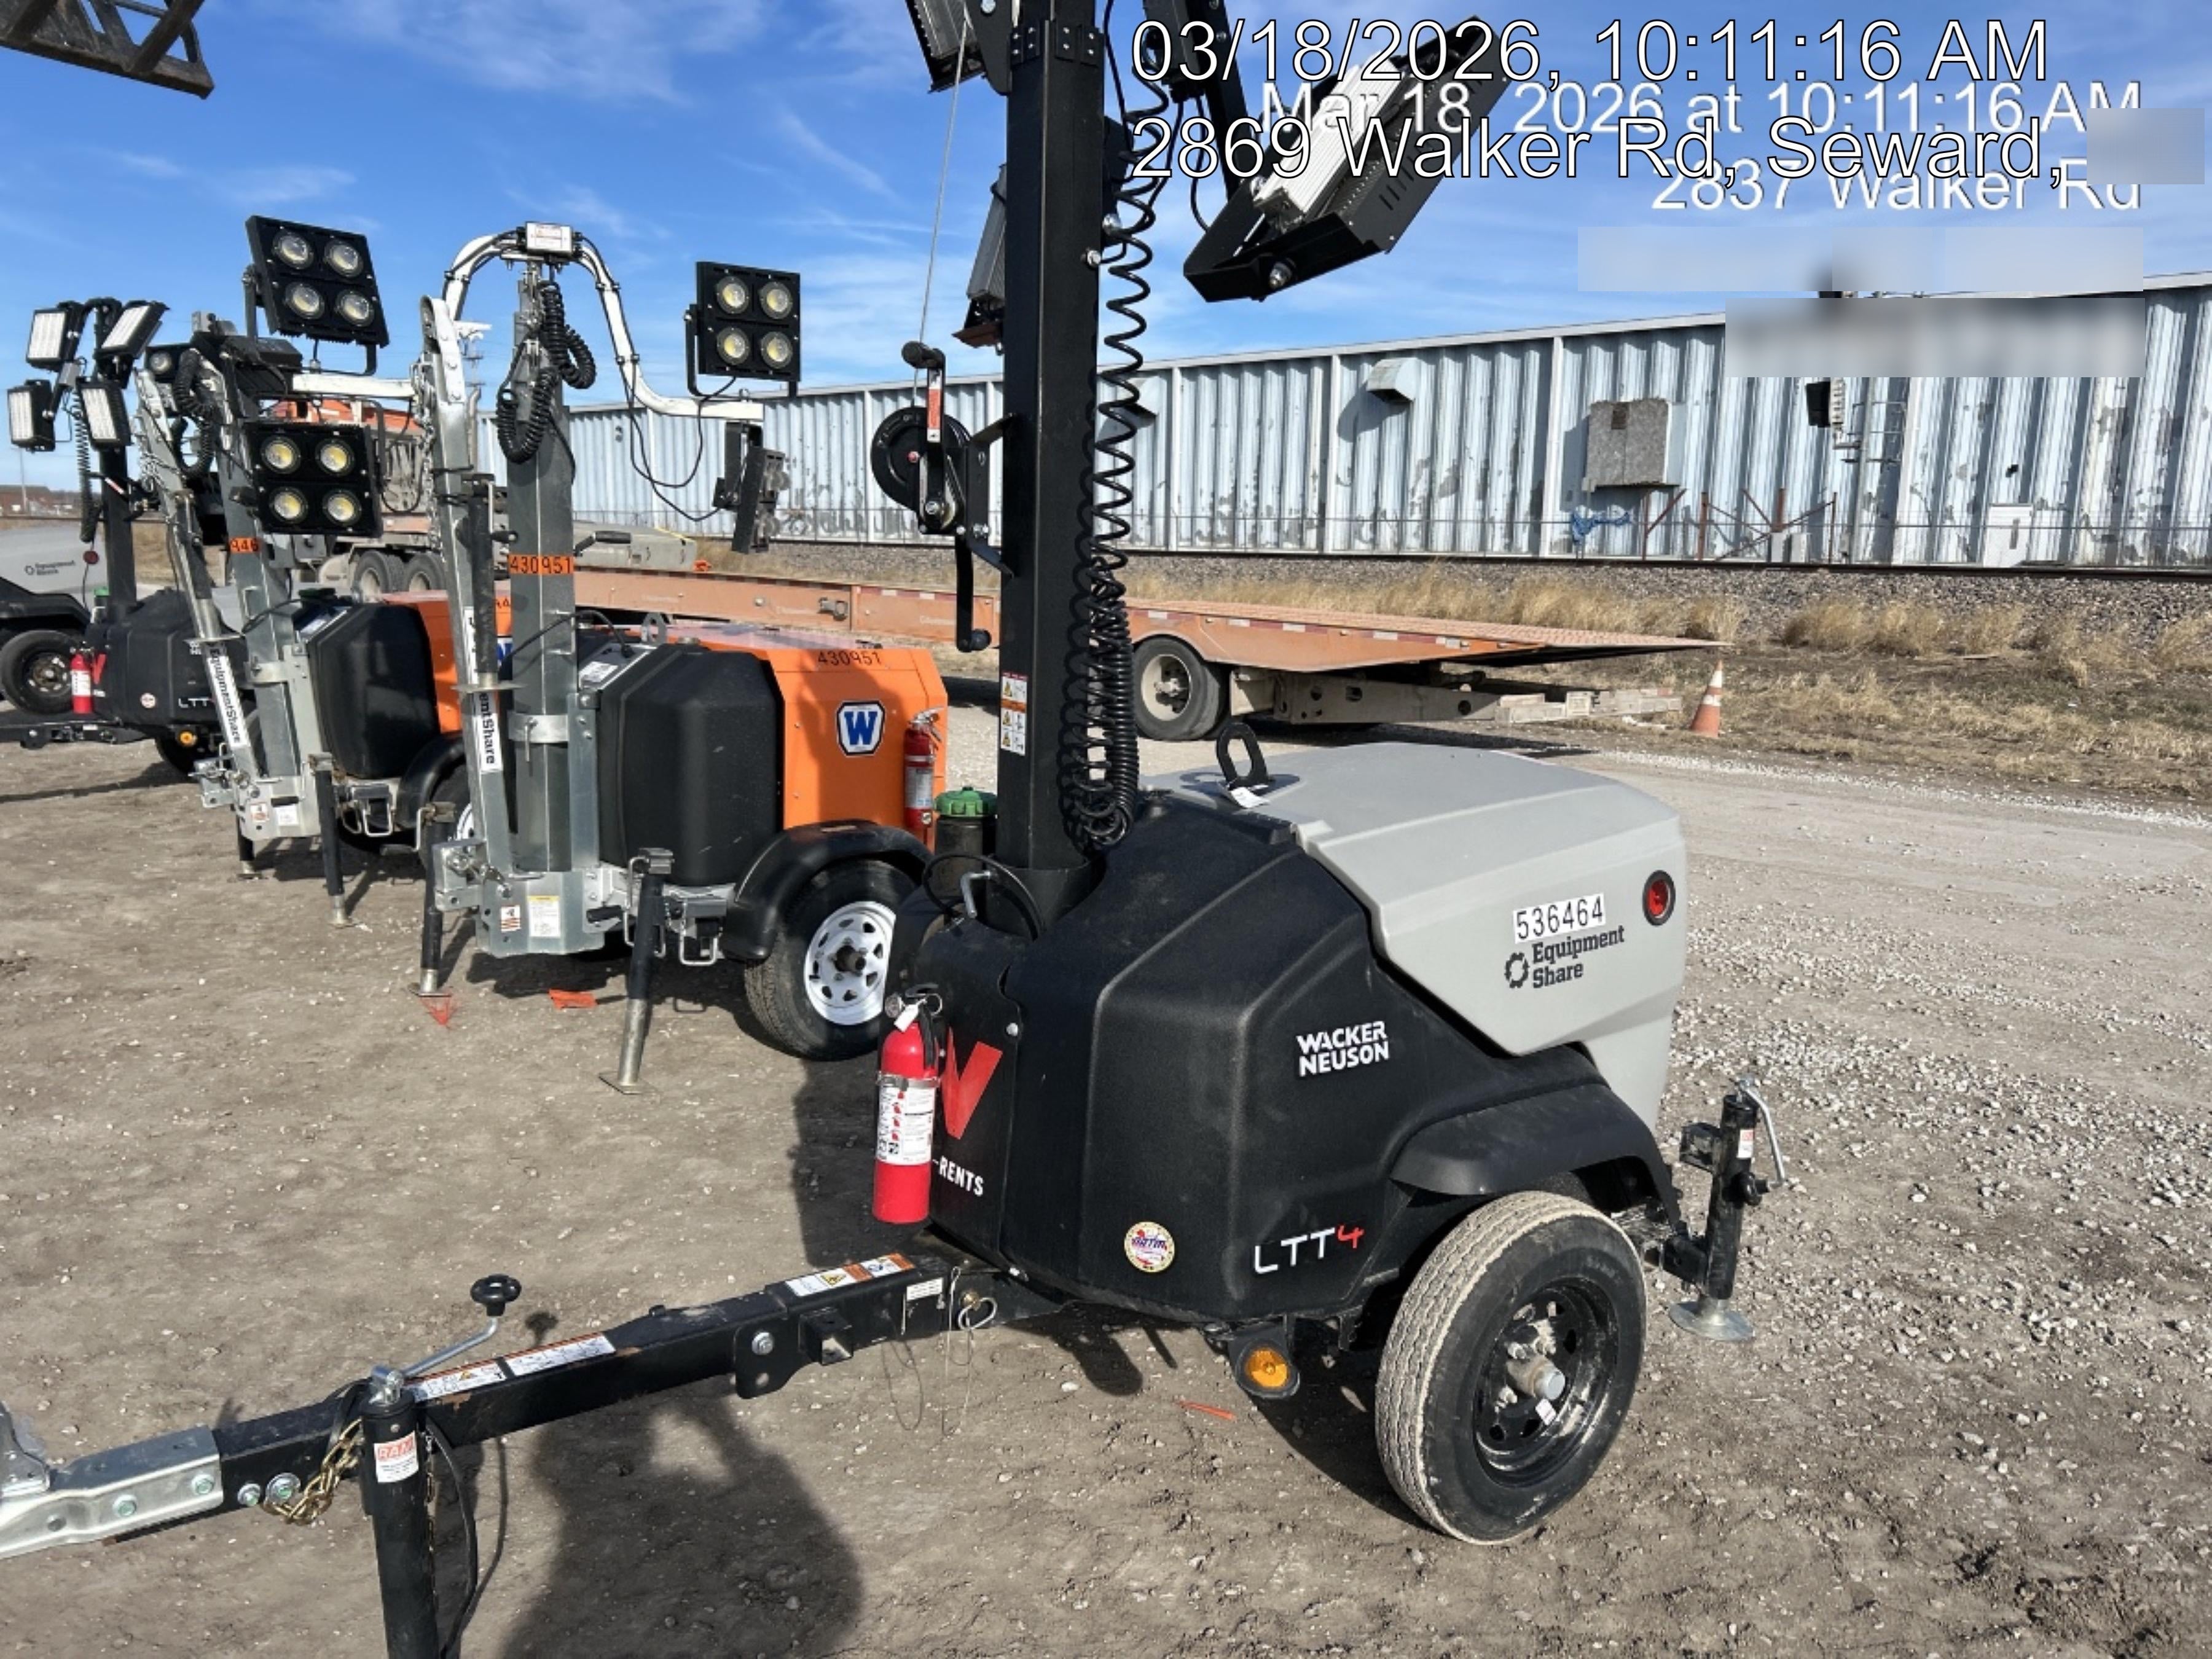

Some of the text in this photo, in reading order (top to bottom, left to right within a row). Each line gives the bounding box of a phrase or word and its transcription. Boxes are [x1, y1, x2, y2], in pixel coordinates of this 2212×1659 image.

[510, 555, 571, 574] 430951
[817, 650, 882, 666] 430951
[844, 711, 878, 745] W
[1516, 895, 1603, 940] 536464
[1531, 924, 1625, 965] Equipment
[1532, 962, 1584, 989] Share
[1296, 1020, 1387, 1056] WACKER
[1299, 1041, 1390, 1077] NEUSON
